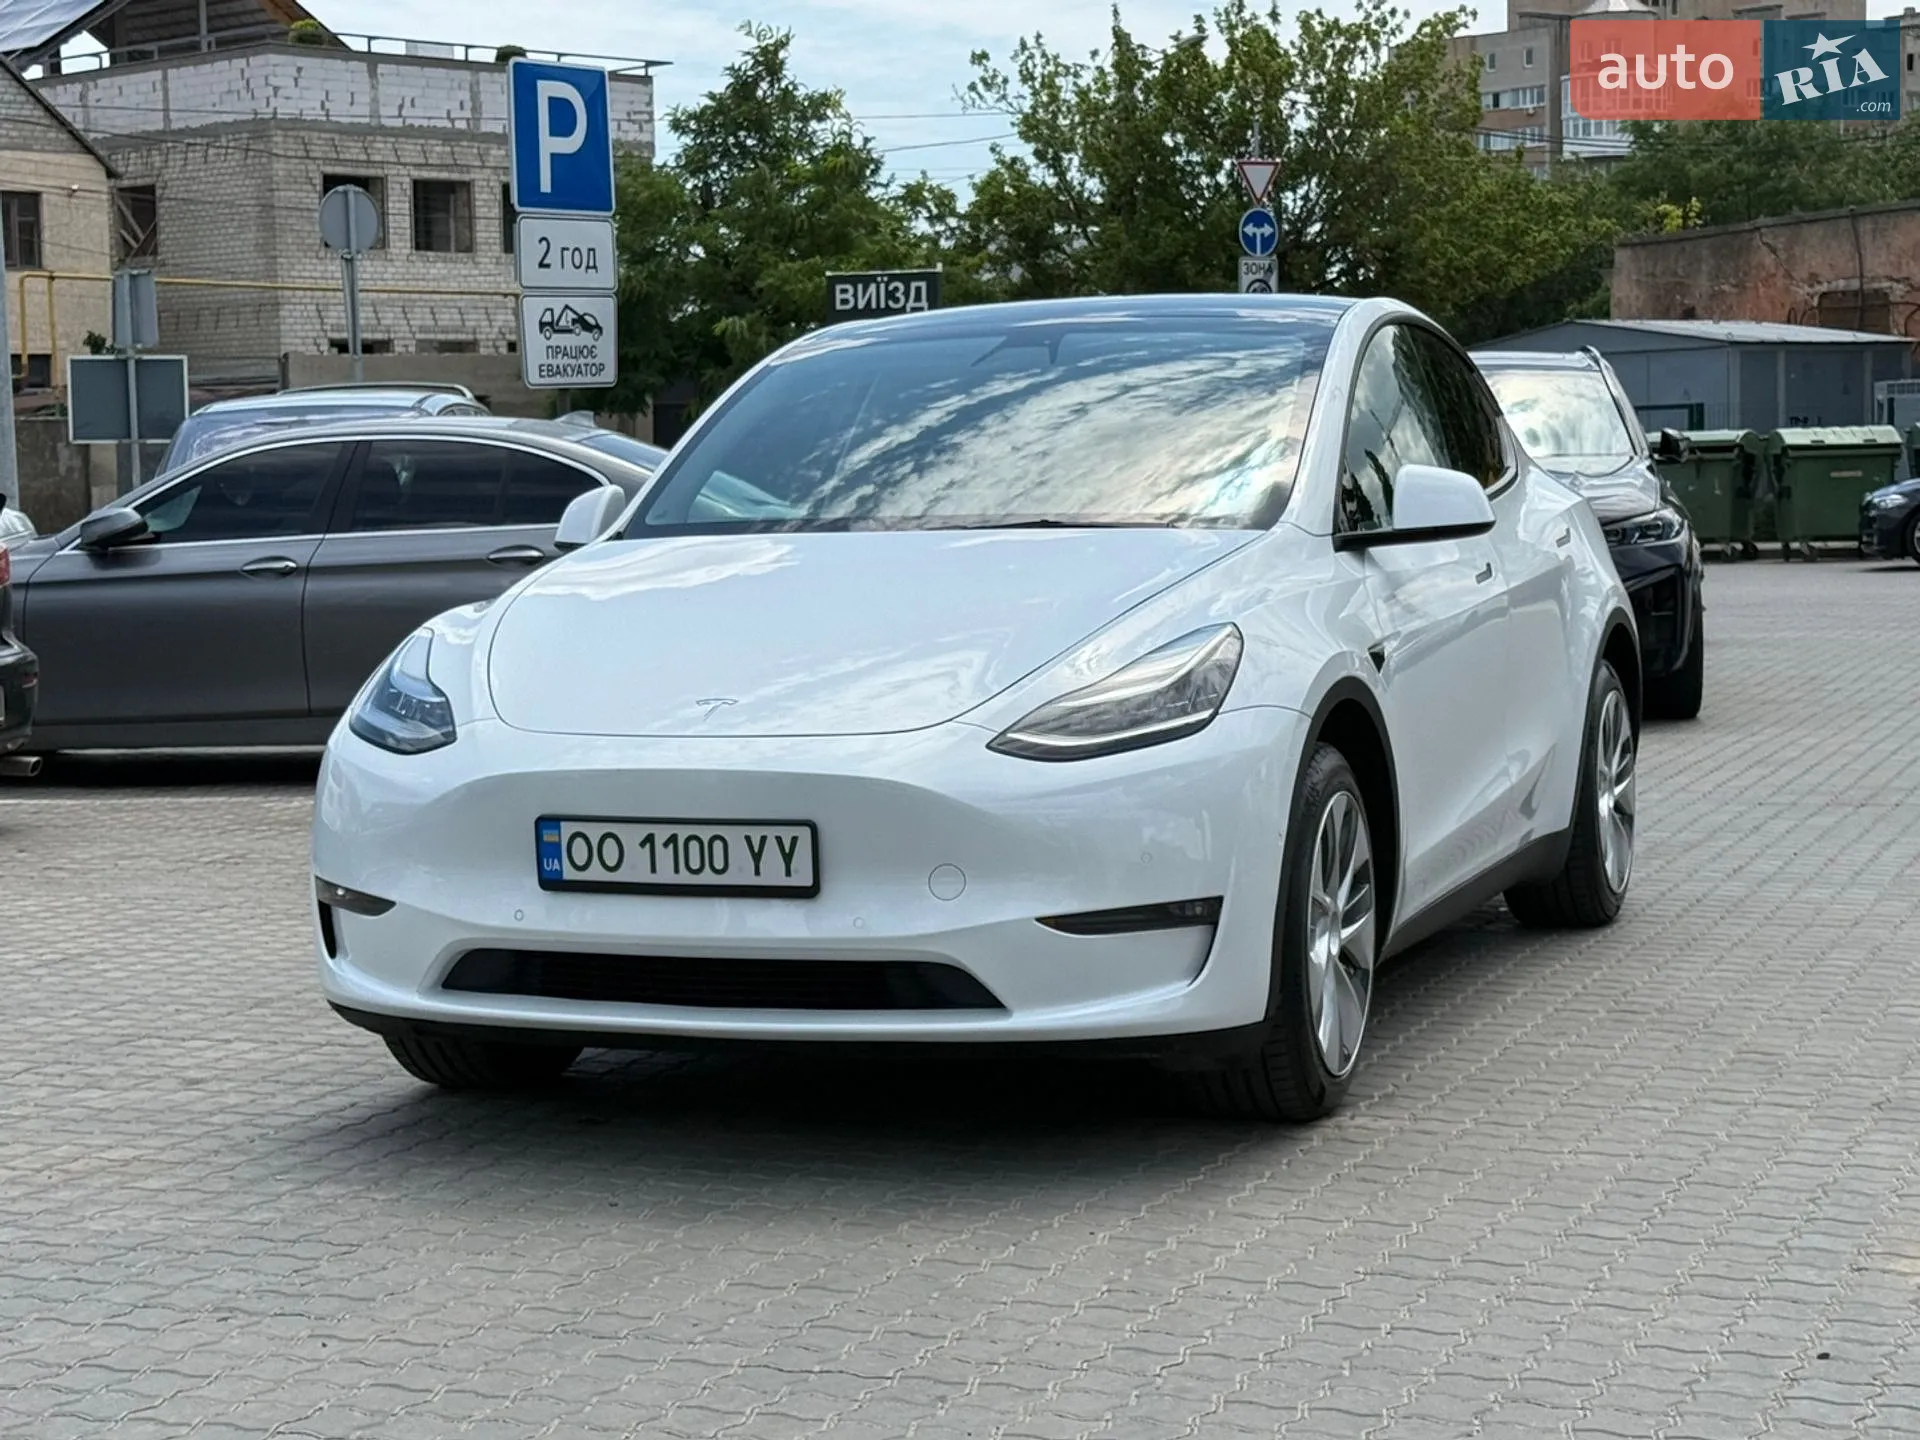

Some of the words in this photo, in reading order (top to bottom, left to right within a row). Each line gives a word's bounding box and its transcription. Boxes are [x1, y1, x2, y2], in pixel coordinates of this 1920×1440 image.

[536, 79, 588, 193] P
[538, 237, 551, 269] 2
[560, 248, 599, 274] год
[835, 276, 929, 313] ВИЇЗД
[538, 362, 606, 379] ЕВАКУАТОР
[546, 344, 598, 361] ПРАЦЮЄ
[544, 858, 560, 871] UA
[566, 831, 625, 873] OO
[638, 832, 730, 876] 1100
[744, 835, 799, 877] YY
